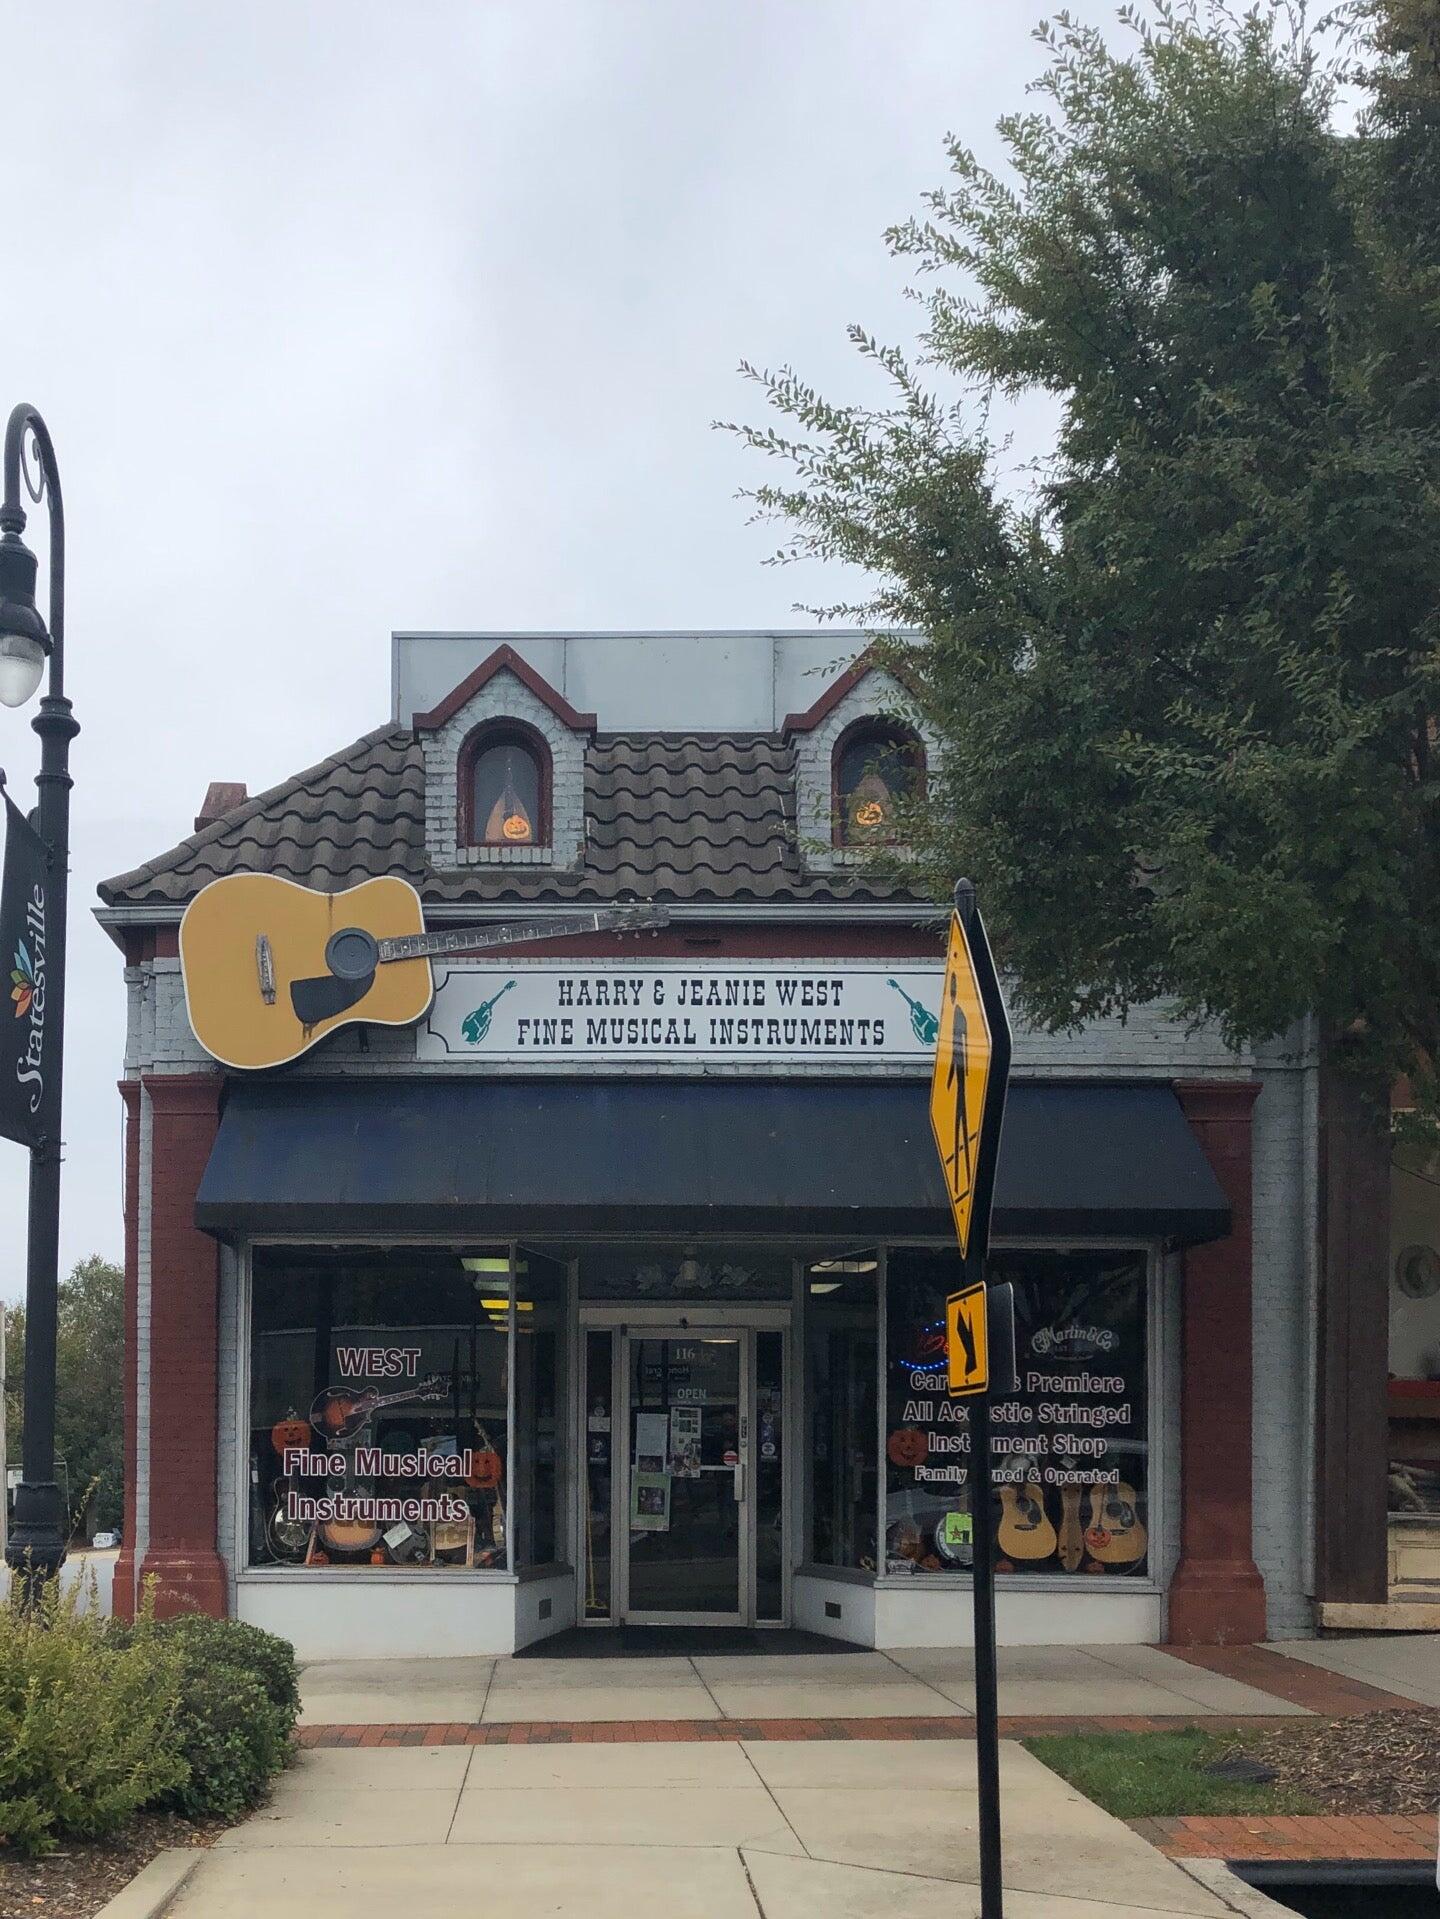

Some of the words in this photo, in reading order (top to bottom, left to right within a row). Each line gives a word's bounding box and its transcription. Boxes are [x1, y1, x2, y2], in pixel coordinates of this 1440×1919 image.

[16, 883, 46, 1114] Statesville
[558, 979, 644, 1006] HARRY
[653, 979, 665, 1006] &
[677, 980, 766, 1006] JEANIE
[775, 980, 844, 1006] WEST
[517, 1018, 573, 1045] FINE
[586, 1018, 697, 1045] MUSICAL
[709, 1018, 885, 1045] INSTRUMENTS
[336, 1347, 421, 1377] WEST
[676, 1348, 695, 1359] 116
[677, 1388, 707, 1400] OPEN
[1026, 1372, 1125, 1393] Premiere
[903, 1400, 933, 1422] All
[937, 1401, 1033, 1423] Acstic
[1037, 1402, 1131, 1428] Stringed
[928, 1431, 1048, 1454] Instment
[1052, 1434, 1107, 1458] Shop
[283, 1448, 346, 1476] Fine
[354, 1448, 472, 1477] Musical
[914, 1465, 967, 1484] Family
[1027, 1468, 1041, 1483] &
[1044, 1467, 1119, 1485] Operated
[287, 1492, 469, 1522] Instruments
